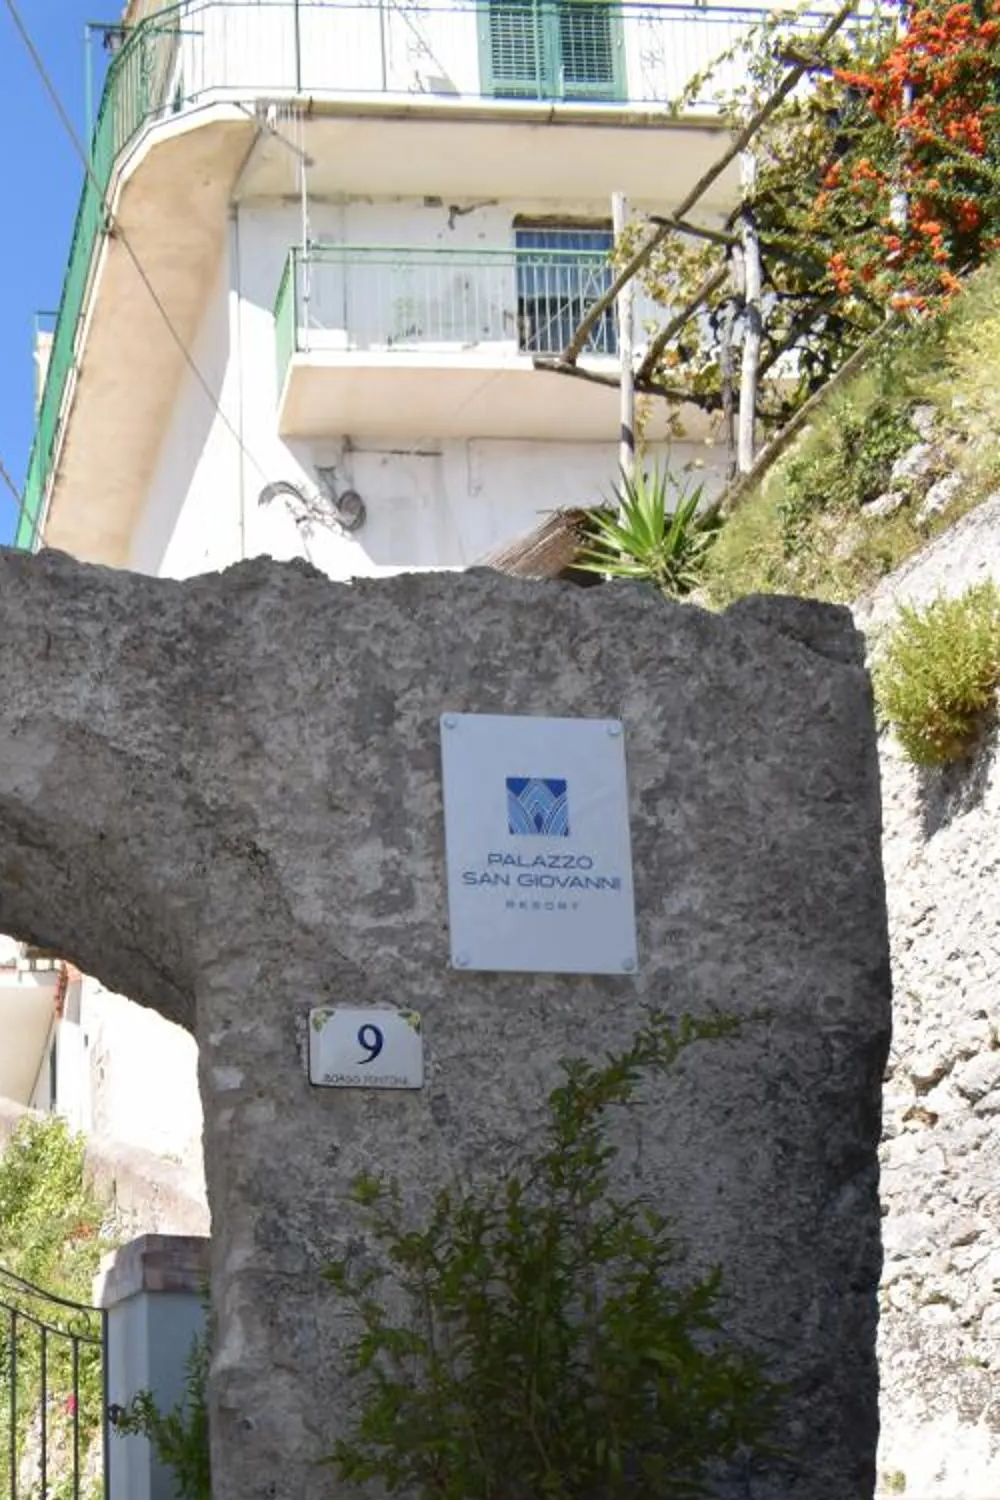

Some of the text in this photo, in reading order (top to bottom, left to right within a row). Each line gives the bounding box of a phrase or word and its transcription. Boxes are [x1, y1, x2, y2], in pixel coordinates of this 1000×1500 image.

[487, 852, 594, 870] PALAZZO
[462, 871, 621, 890] SAN GIOVANNI
[505, 899, 579, 911] RESORT
[357, 1023, 384, 1065] 9
